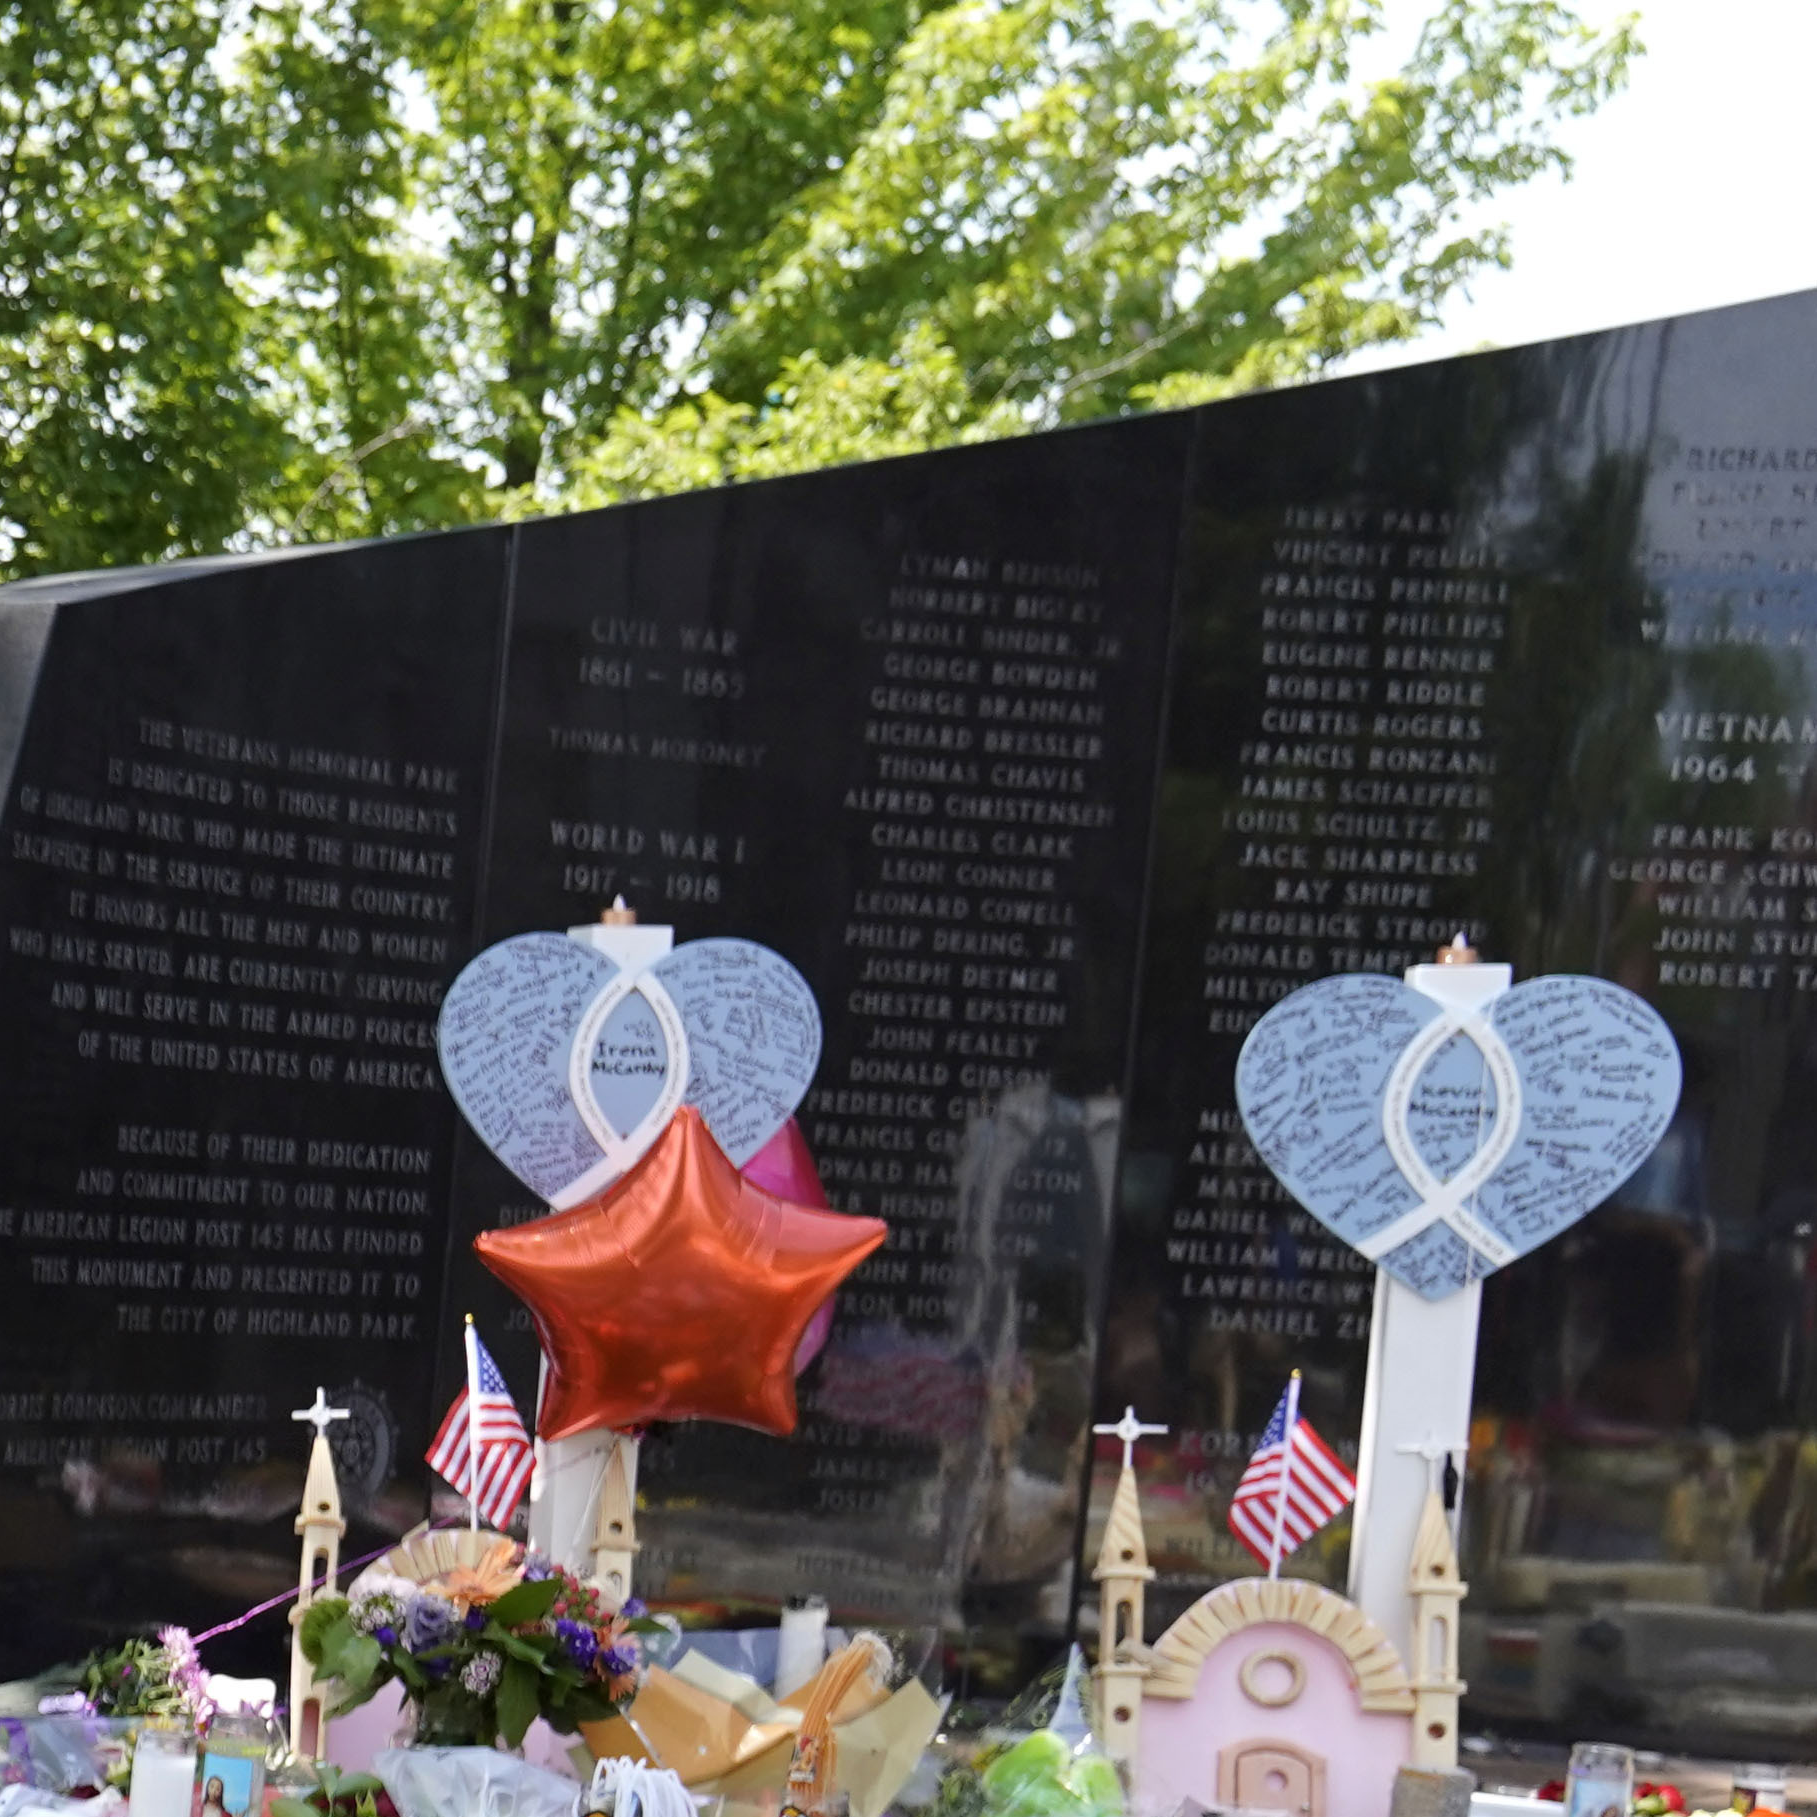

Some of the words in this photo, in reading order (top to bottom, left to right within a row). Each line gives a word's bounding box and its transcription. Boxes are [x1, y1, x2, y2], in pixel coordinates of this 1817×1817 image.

[1670, 754, 1757, 784] 1964
[131, 761, 232, 803] DEDICATED
[241, 778, 265, 808] TO
[277, 784, 338, 819] THOSE
[347, 795, 458, 838] RESIDENTS
[137, 803, 185, 837] PARK
[193, 812, 235, 845] WHO
[242, 820, 295, 855] MADE
[304, 829, 341, 862] THE
[350, 836, 453, 880] ULTIMATE
[97, 843, 115, 873] IN
[126, 847, 158, 879] THE
[166, 853, 241, 891] SERVICE
[250, 865, 274, 896] OF
[284, 870, 340, 906] THEIR
[94, 892, 166, 930] HONORS
[174, 902, 210, 935] ALL
[220, 908, 254, 940] THE
[265, 913, 308, 946] MEN
[317, 920, 359, 952] AND
[369, 926, 446, 962] WOMEN
[9, 927, 45, 956] WHO
[50, 932, 96, 963] HAVE
[183, 949, 221, 978] ARE
[228, 954, 348, 994] CURRENTLY
[50, 981, 87, 1012] AND
[93, 986, 133, 1017] WILL
[143, 991, 198, 1023] SERVE
[208, 998, 229, 1027] IN
[238, 1001, 277, 1032] THE
[286, 1006, 355, 1040] ARMED
[78, 1030, 100, 1059] OF
[108, 1033, 143, 1063] THE
[151, 1036, 220, 1070] UNITED
[226, 1043, 300, 1078] STATES
[309, 1050, 334, 1081] OF
[117, 1125, 199, 1158] BECAUSE
[207, 1132, 230, 1160] OF
[240, 1134, 296, 1165] THEIR
[306, 1139, 430, 1174] DEDICATION
[76, 1168, 113, 1197] AND
[122, 1171, 249, 1204] COMMITMENT
[259, 1179, 286, 1206] TO
[294, 1181, 334, 1209] OUR
[20, 1208, 111, 1241] AMERICAN
[118, 1214, 185, 1245] LEGION
[195, 1218, 243, 1248] POST
[293, 1224, 334, 1252] HAS
[343, 1226, 424, 1256] FUNDED
[31, 1256, 67, 1285] THIS
[76, 1258, 184, 1289] MONUMENT
[191, 1263, 233, 1291] AND
[241, 1265, 351, 1296] PRESENTED
[361, 1270, 383, 1297] IT
[392, 1271, 420, 1298] TO
[116, 1304, 152, 1332] THE
[160, 1305, 205, 1334] CITY
[213, 1307, 239, 1335] OF
[246, 1308, 350, 1338] HIGHLAND
